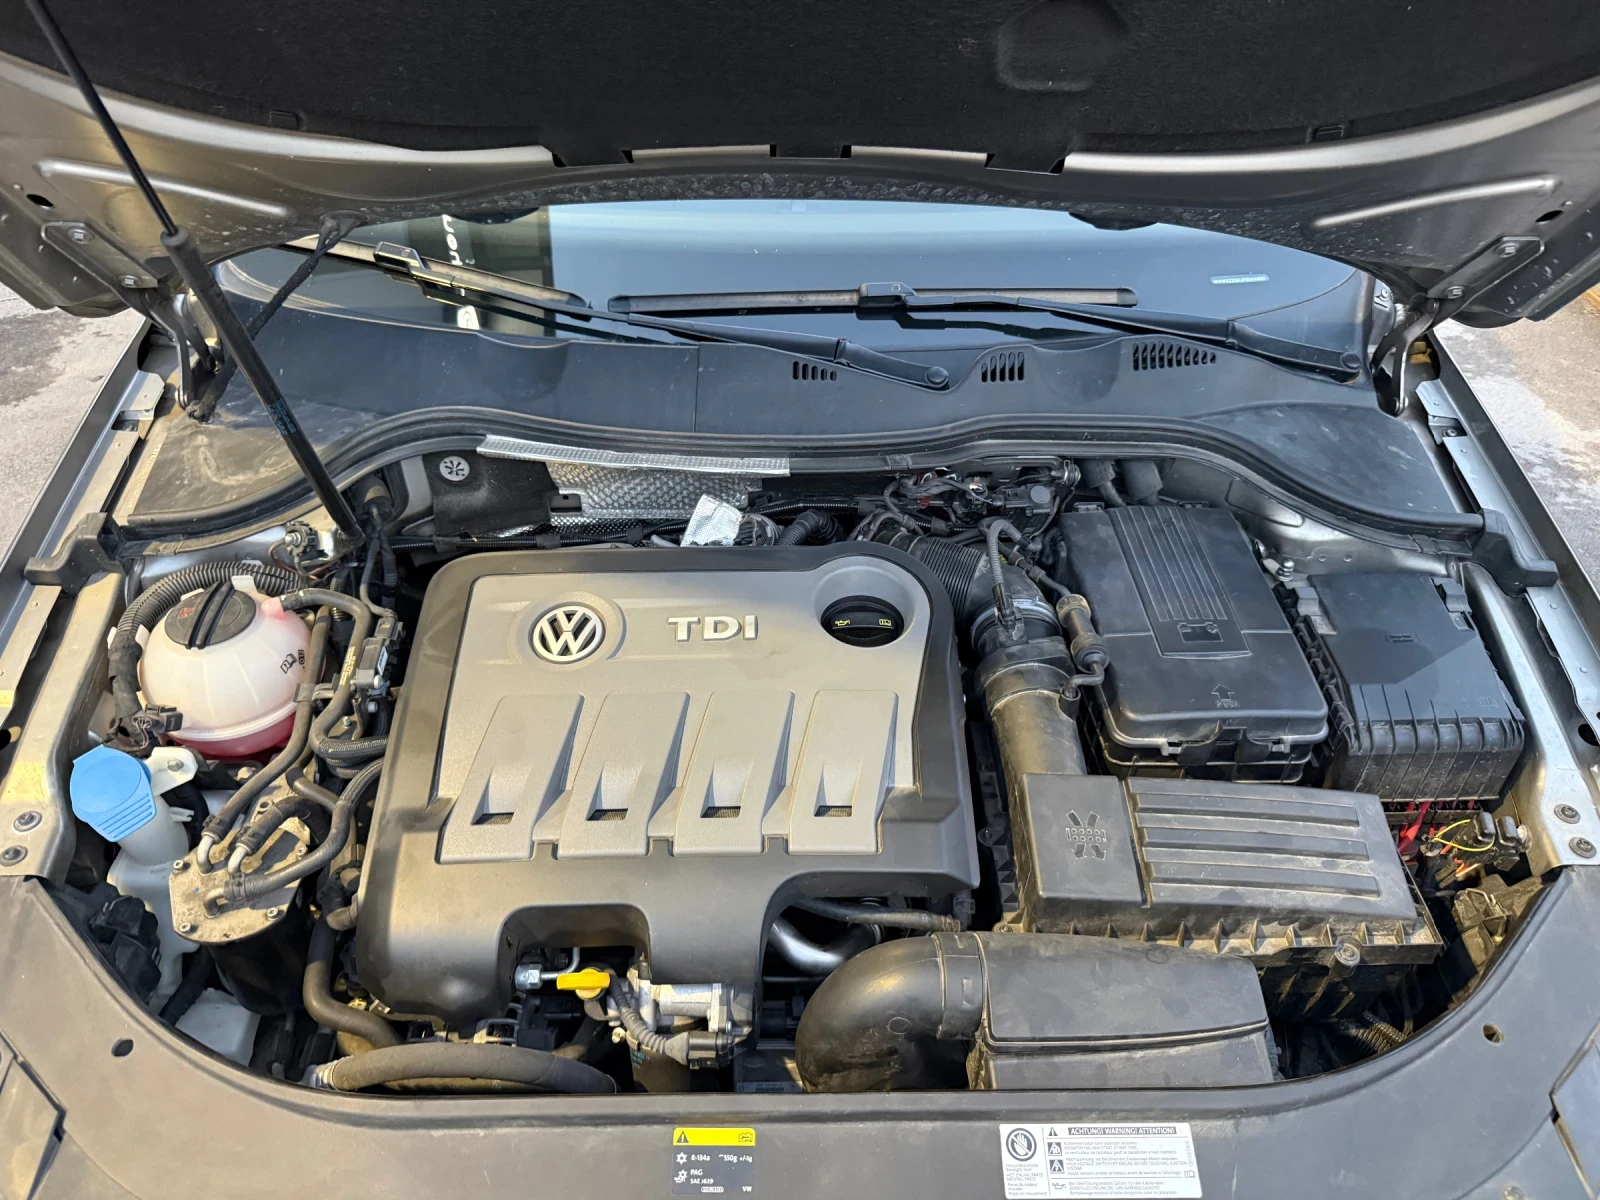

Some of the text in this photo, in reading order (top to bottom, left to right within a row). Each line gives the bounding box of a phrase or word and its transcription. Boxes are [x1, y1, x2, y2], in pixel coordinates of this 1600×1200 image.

[667, 615, 758, 642] TDI
[1070, 1127, 1103, 1135] ACHTUNG!
[1104, 1127, 1137, 1135] WARNING!
